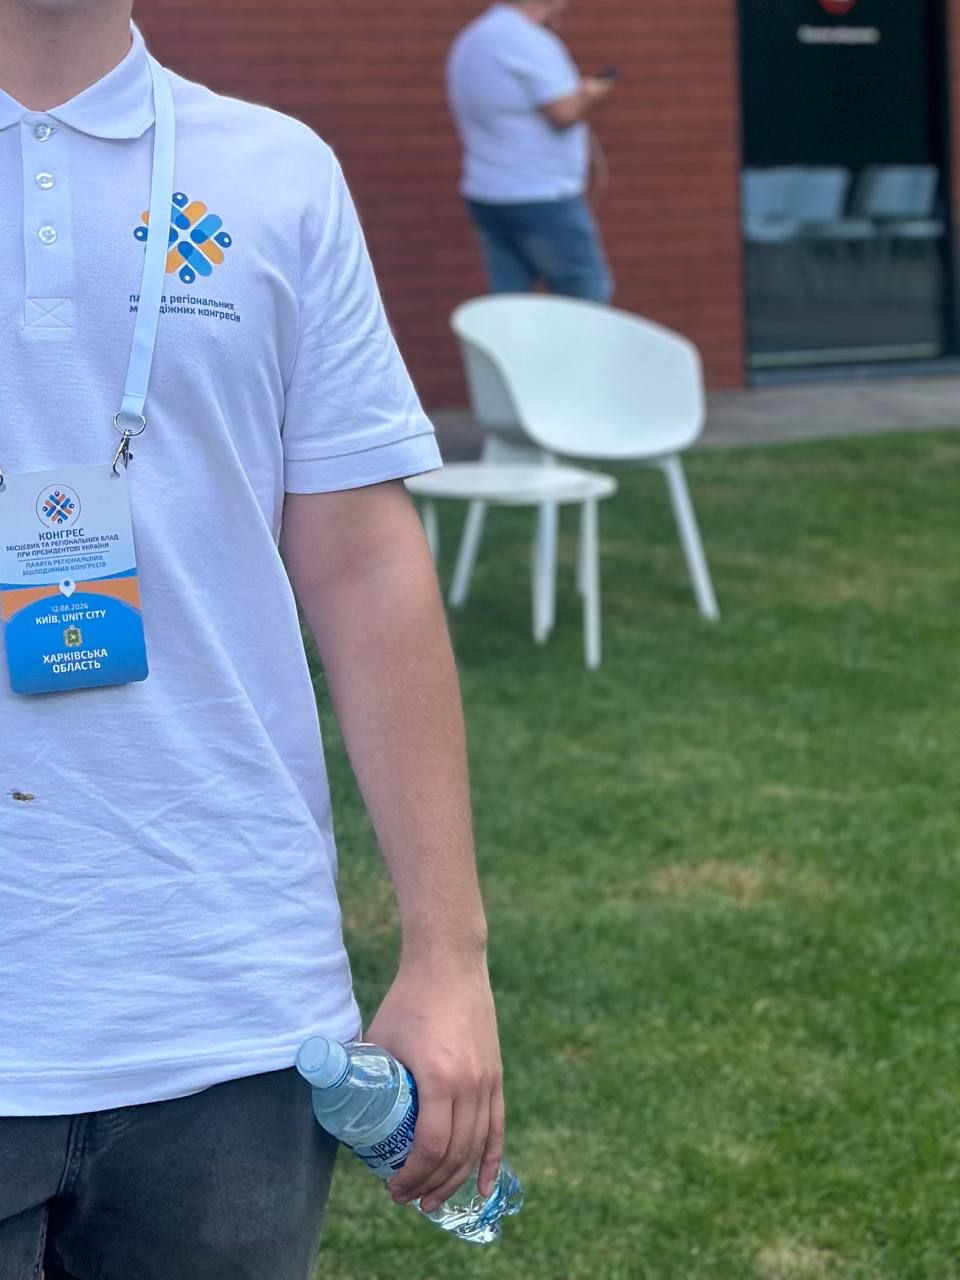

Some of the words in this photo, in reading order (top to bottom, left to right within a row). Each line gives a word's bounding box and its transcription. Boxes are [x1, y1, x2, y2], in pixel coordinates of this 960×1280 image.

[169, 294, 235, 310] регіональних
[129, 304, 196, 314] мдіжних
[198, 308, 241, 322] конгресів
[39, 528, 85, 541] КОНГРЕС
[6, 543, 40, 552] МІСЦЕВИХ
[51, 537, 100, 547] РЕГІОНАЛЬНИХ
[32, 546, 81, 557] ПРЕЗИДЕНТОВІ
[82, 542, 109, 551] УКРАЇНИ
[36, 613, 60, 624] КИЇВ,
[62, 612, 84, 622] UNIT
[86, 609, 106, 619] CITY
[42, 648, 108, 664] ХАРКІВСЬКА
[52, 660, 101, 673] ОБЛАСТЬ
